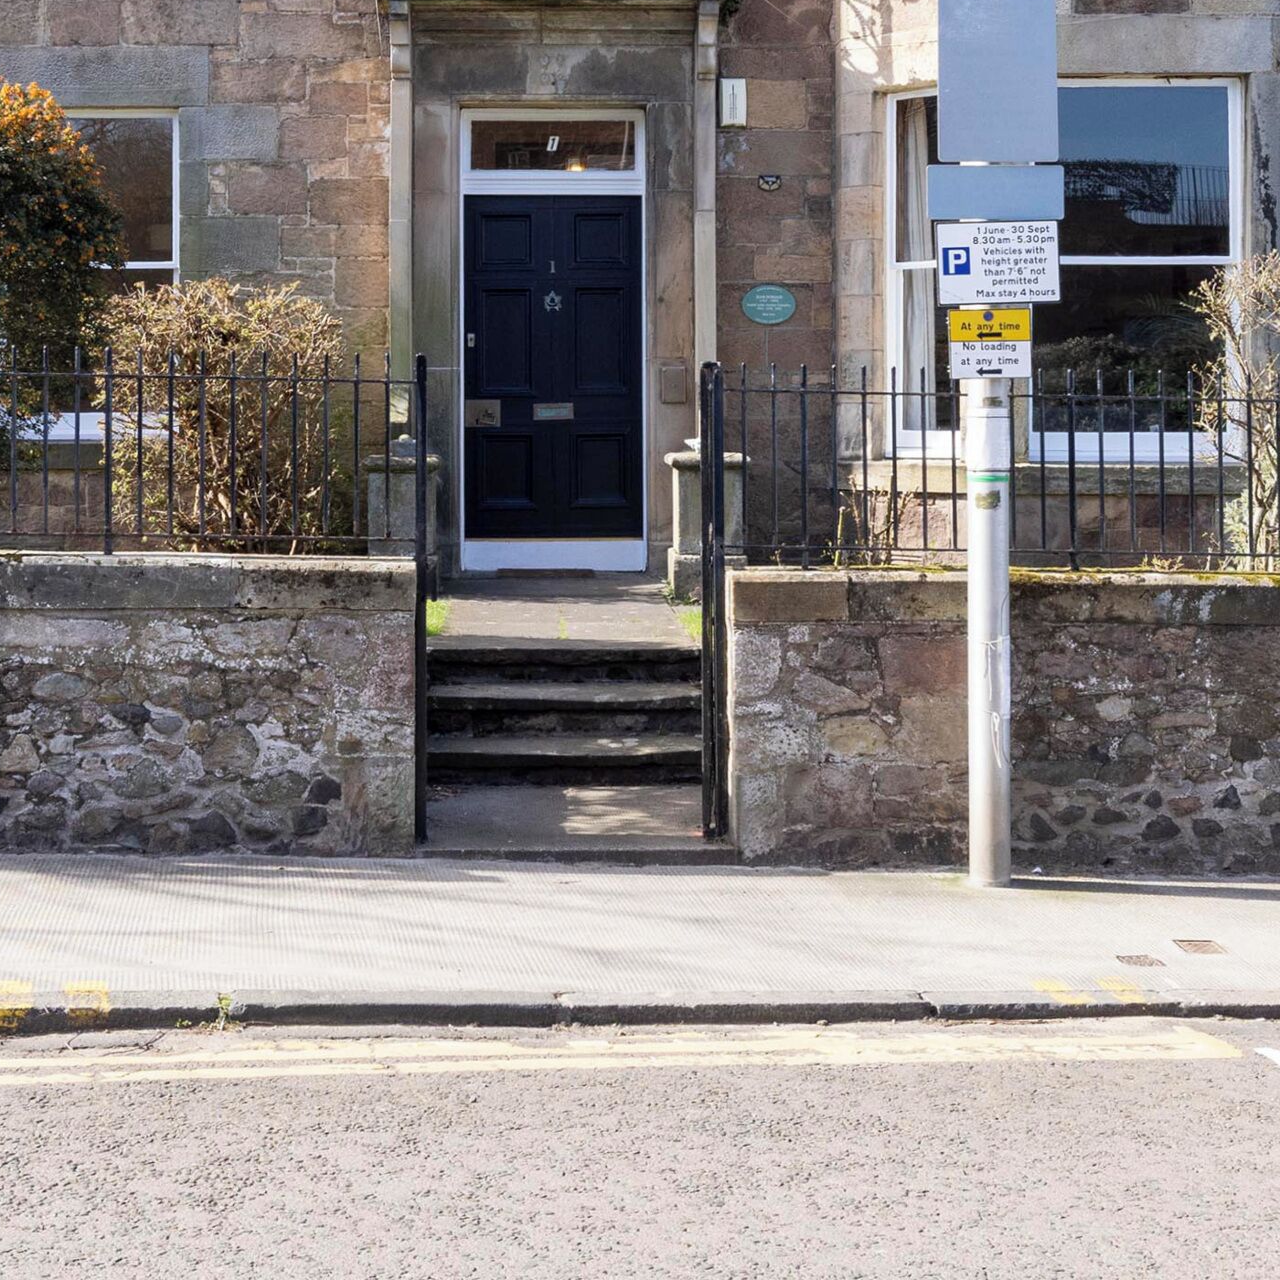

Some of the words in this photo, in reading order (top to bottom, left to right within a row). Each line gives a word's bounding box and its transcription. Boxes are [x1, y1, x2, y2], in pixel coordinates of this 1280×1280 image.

[984, 226, 1005, 235] June
[1011, 226, 1024, 234] 30
[1027, 225, 1050, 234] Sept
[983, 246, 1022, 256] Vehicles
[1025, 246, 1045, 255] with
[948, 249, 967, 274] P
[981, 256, 1011, 267] height
[1013, 256, 1048, 266] greater
[549, 261, 555, 273] 1
[984, 268, 1005, 277] than
[1030, 267, 1046, 275] not
[992, 276, 1039, 286] permitted
[976, 290, 996, 298] Max
[999, 289, 1019, 299] stay
[1020, 289, 1027, 297] 4
[1029, 287, 1056, 296] hours
[961, 322, 971, 331] At
[976, 323, 994, 332] any
[999, 322, 1020, 330] time
[962, 342, 976, 351] No
[980, 342, 1017, 352] loading
[960, 357, 971, 366] at
[975, 358, 993, 367] any
[998, 356, 1019, 365] time
